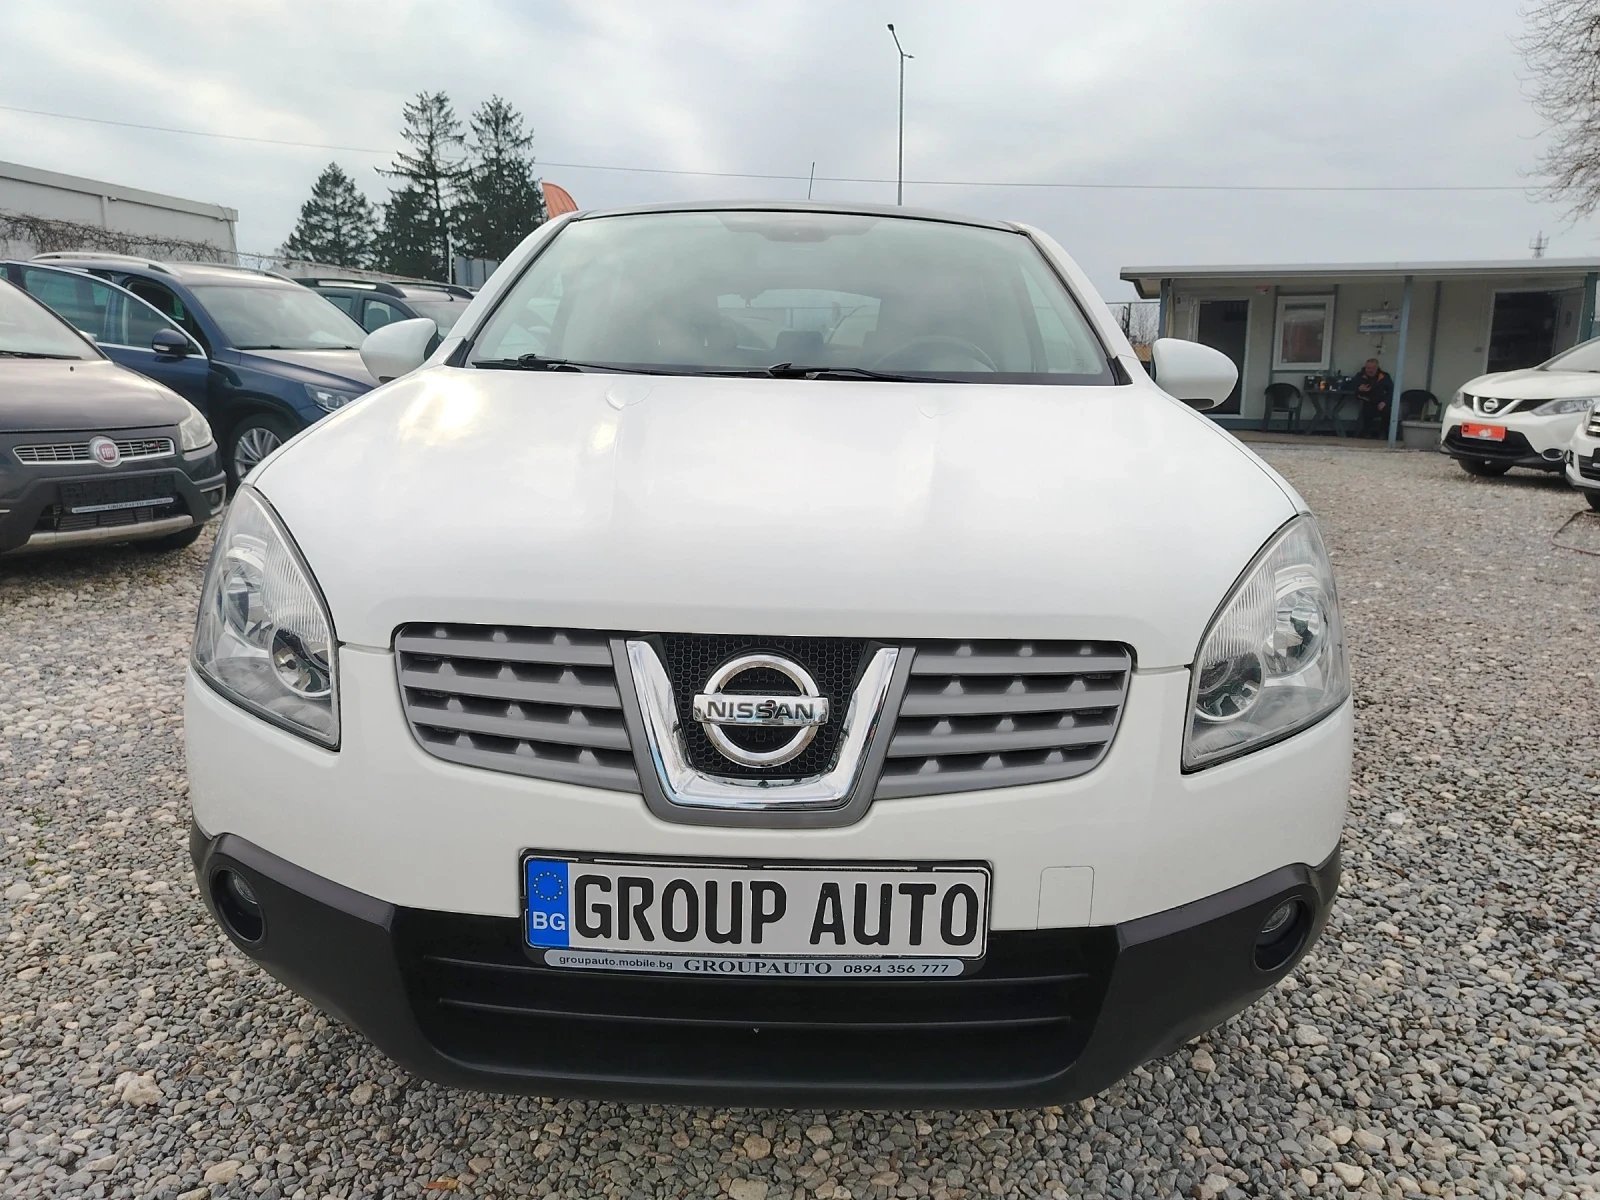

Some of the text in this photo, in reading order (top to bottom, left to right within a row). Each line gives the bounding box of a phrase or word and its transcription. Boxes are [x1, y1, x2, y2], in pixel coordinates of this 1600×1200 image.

[707, 701, 814, 720] NISSAN
[574, 874, 979, 947] GROUP AUTO
[532, 911, 566, 931] BG
[559, 956, 949, 975] groupauto.mobile.bg GROUPAUTO 0894 356 777
